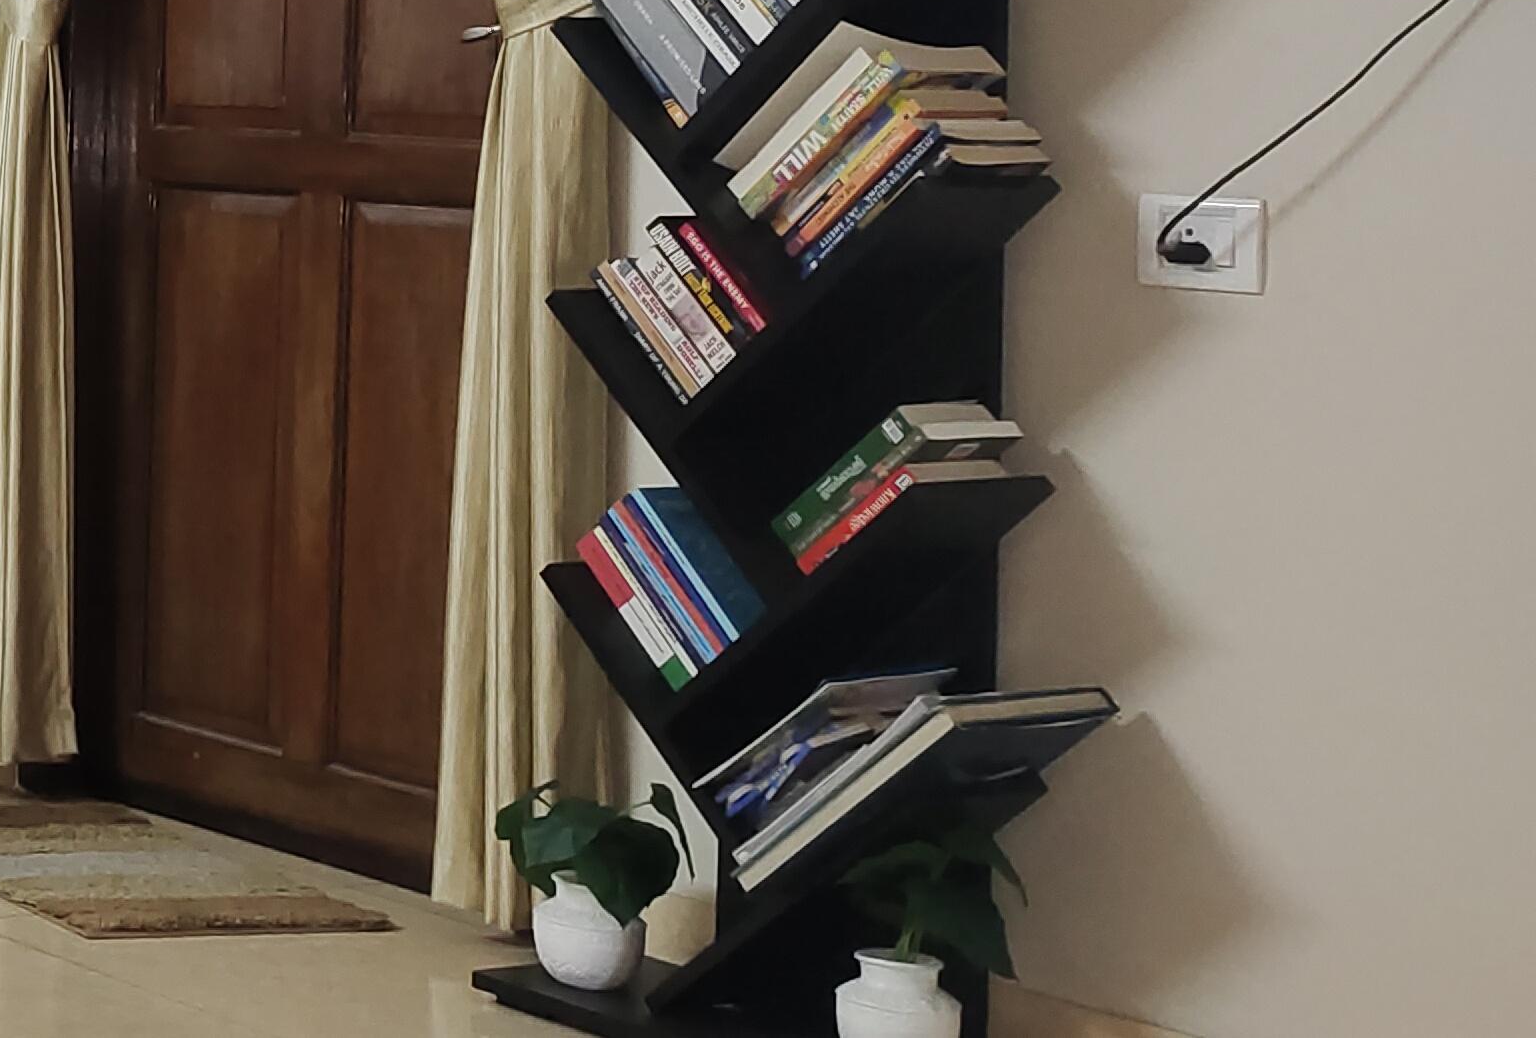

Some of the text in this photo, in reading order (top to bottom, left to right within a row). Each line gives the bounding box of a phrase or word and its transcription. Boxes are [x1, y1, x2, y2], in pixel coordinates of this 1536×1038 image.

[770, 128, 828, 186] WILL
[647, 222, 681, 257] USAIN
[667, 248, 696, 277] BOLT
[684, 231, 706, 254] EGO
[707, 260, 726, 279] THE
[720, 277, 751, 311] ENEMY
